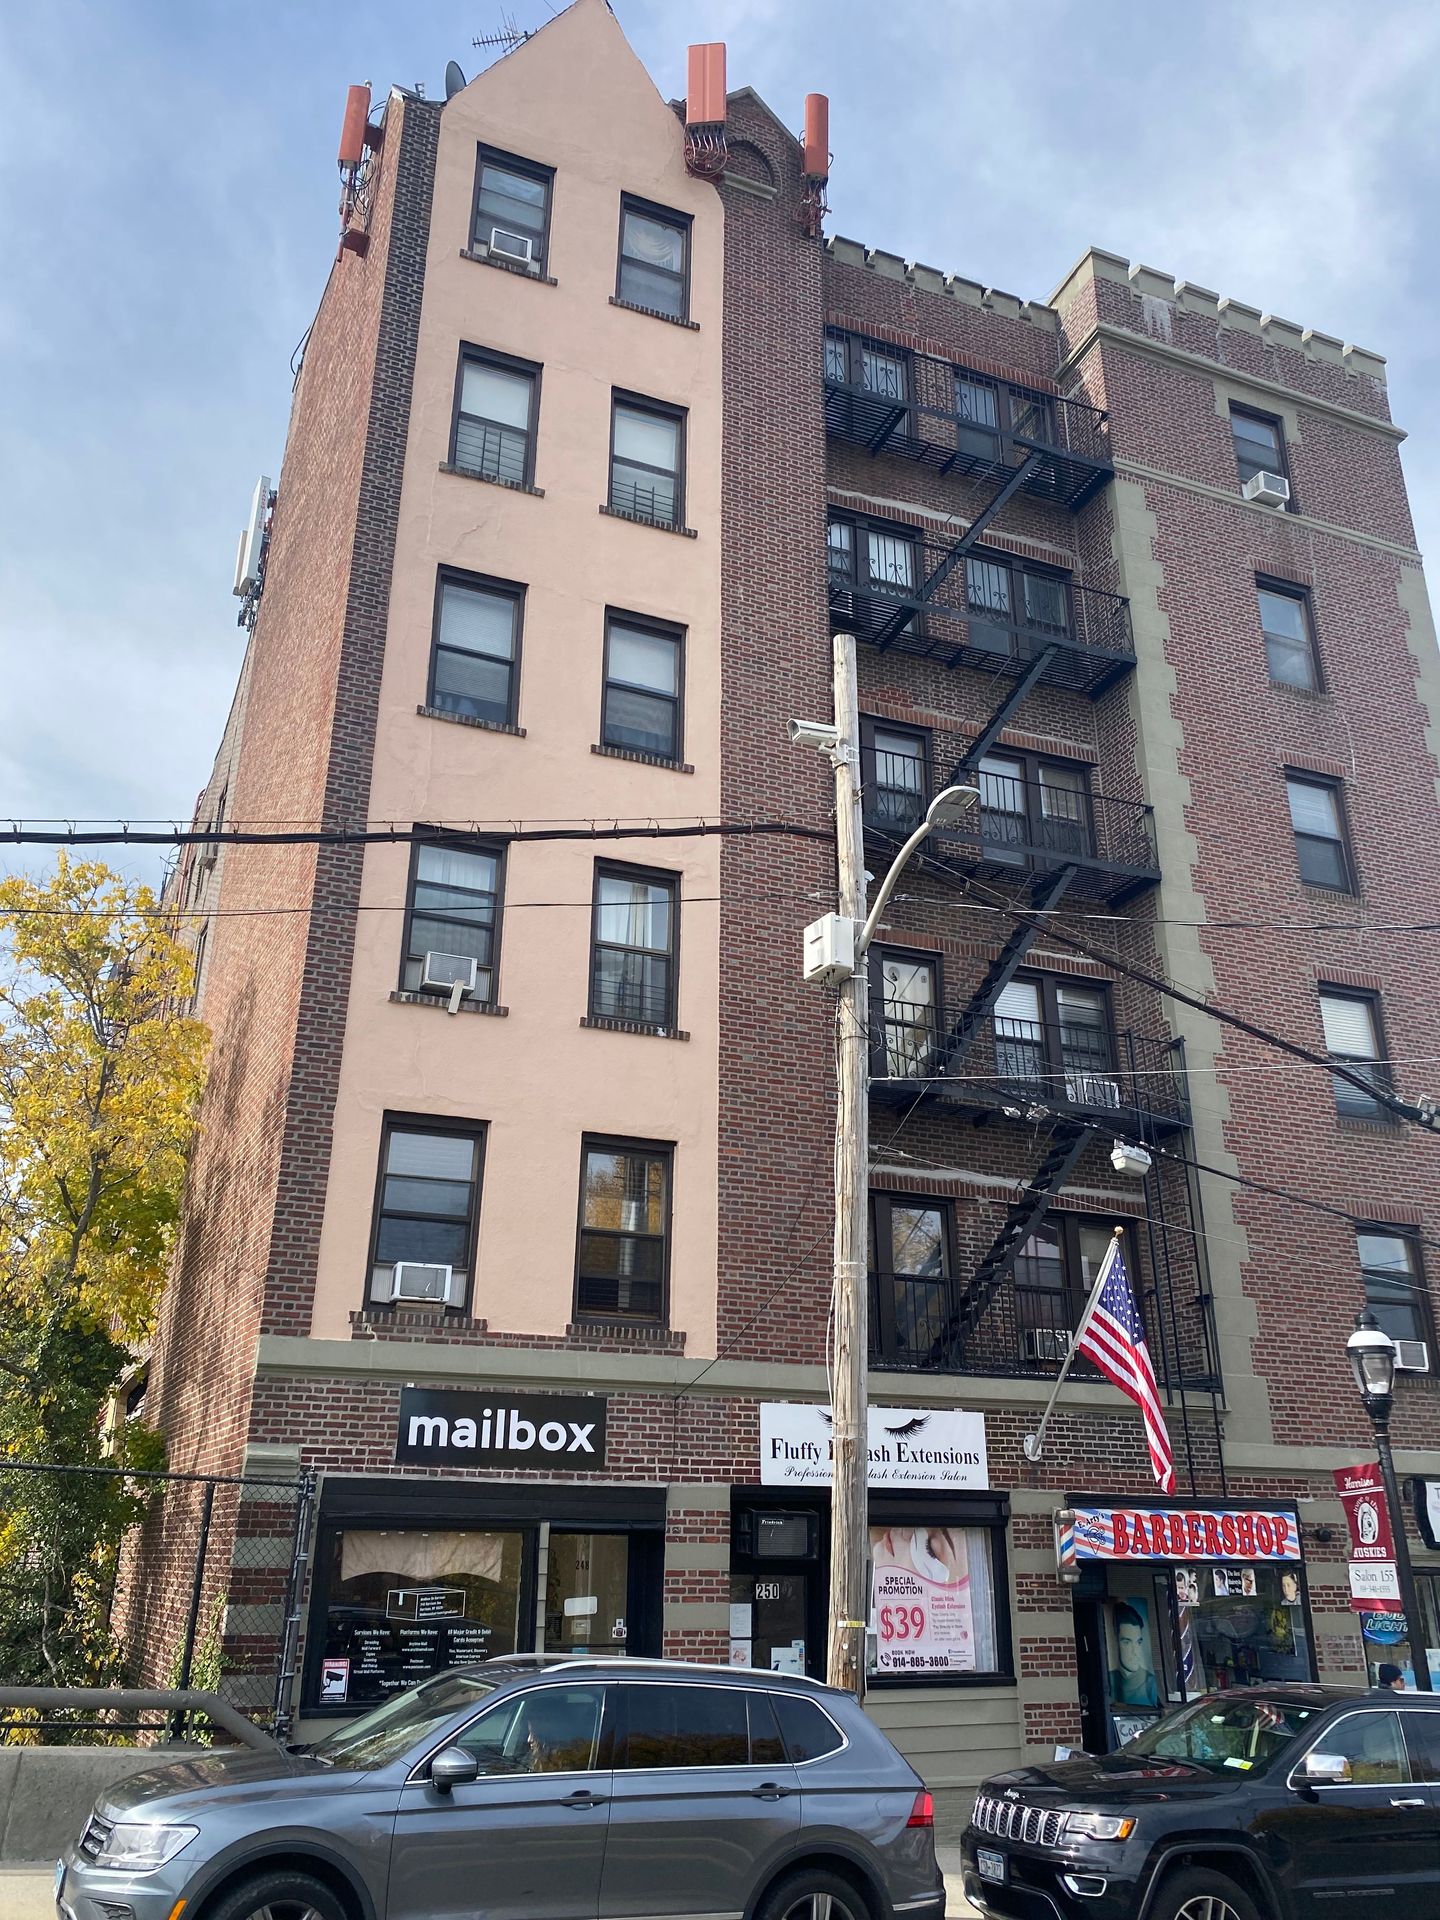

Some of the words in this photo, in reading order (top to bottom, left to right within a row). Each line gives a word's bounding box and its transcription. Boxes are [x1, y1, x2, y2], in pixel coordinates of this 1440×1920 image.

[407, 1408, 596, 1453] mailbox
[771, 1437, 822, 1465] Fluffy
[896, 1441, 980, 1465] Extensions
[784, 1466, 833, 1482] Profession
[868, 1469, 888, 1480] lash
[891, 1469, 936, 1481] Extension
[940, 1470, 968, 1482] Salon
[1085, 1512, 1105, 1527] Arty's
[1111, 1513, 1289, 1556] BARBERSHOP
[575, 1560, 590, 1570] 248
[885, 1576, 915, 1585] SPECIAL
[1354, 1569, 1378, 1582] Salon
[1380, 1570, 1395, 1582] 155
[756, 1584, 779, 1600] 250
[878, 1586, 923, 1595] PROMOTION
[880, 1605, 925, 1642] $39
